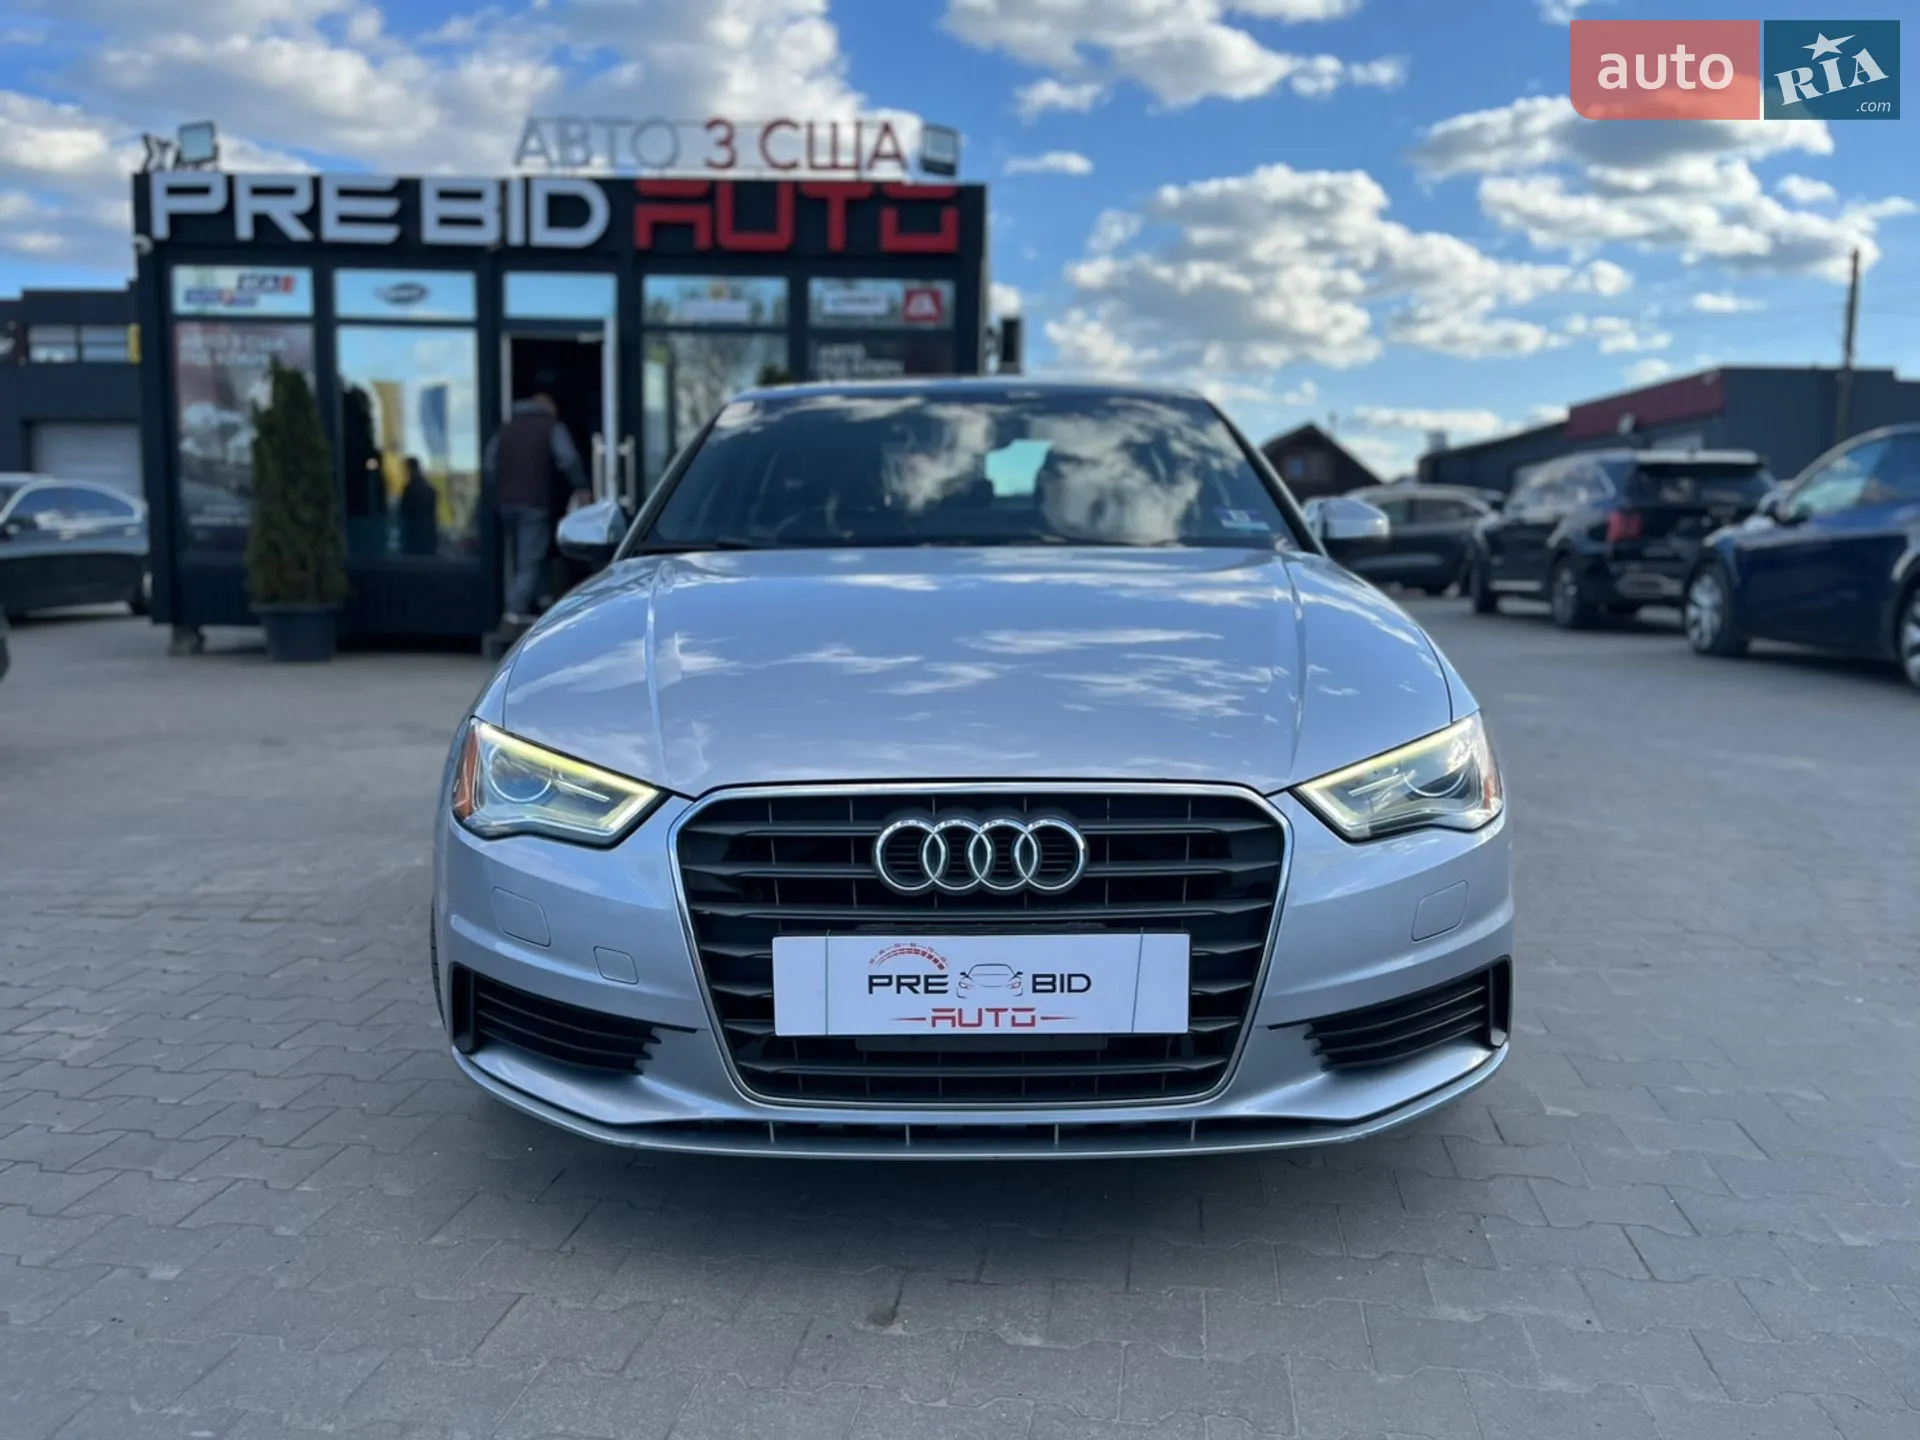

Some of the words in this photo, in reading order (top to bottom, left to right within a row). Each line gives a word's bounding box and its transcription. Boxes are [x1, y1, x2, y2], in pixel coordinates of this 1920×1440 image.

[514, 116, 682, 169] АВТО
[759, 118, 909, 172] США
[149, 173, 401, 243] PRE
[421, 176, 612, 249] BID
[633, 179, 960, 252] AUTO
[868, 974, 949, 994] PRE
[1031, 973, 1093, 993] BID
[931, 1007, 1037, 1028] AUTO
